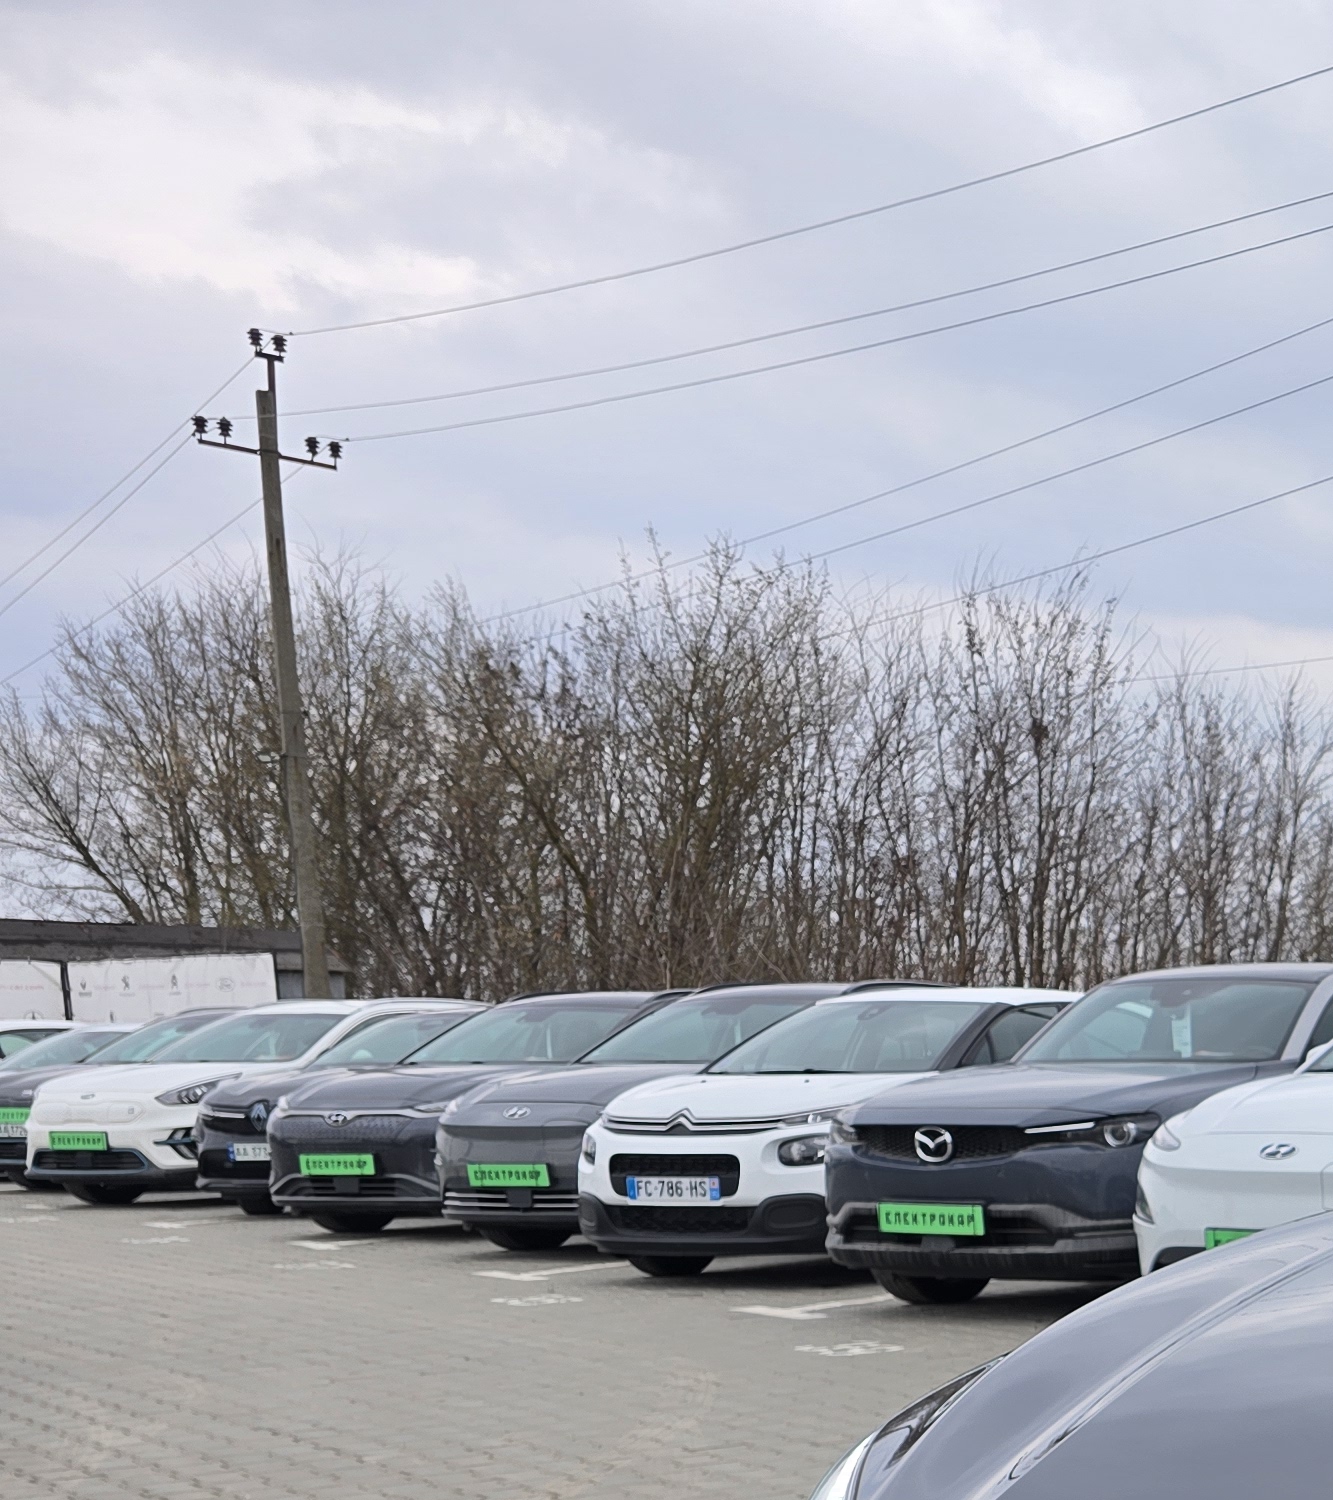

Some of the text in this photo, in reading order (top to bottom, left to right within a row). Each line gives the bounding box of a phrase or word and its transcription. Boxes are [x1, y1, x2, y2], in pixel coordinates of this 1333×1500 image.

[305, 1158, 368, 1170] ЕЛЕКТРОКАР
[473, 1169, 542, 1181] ЕЛЕКТРОКАР
[885, 1211, 975, 1227] ЕЛЕКТРОКАР
